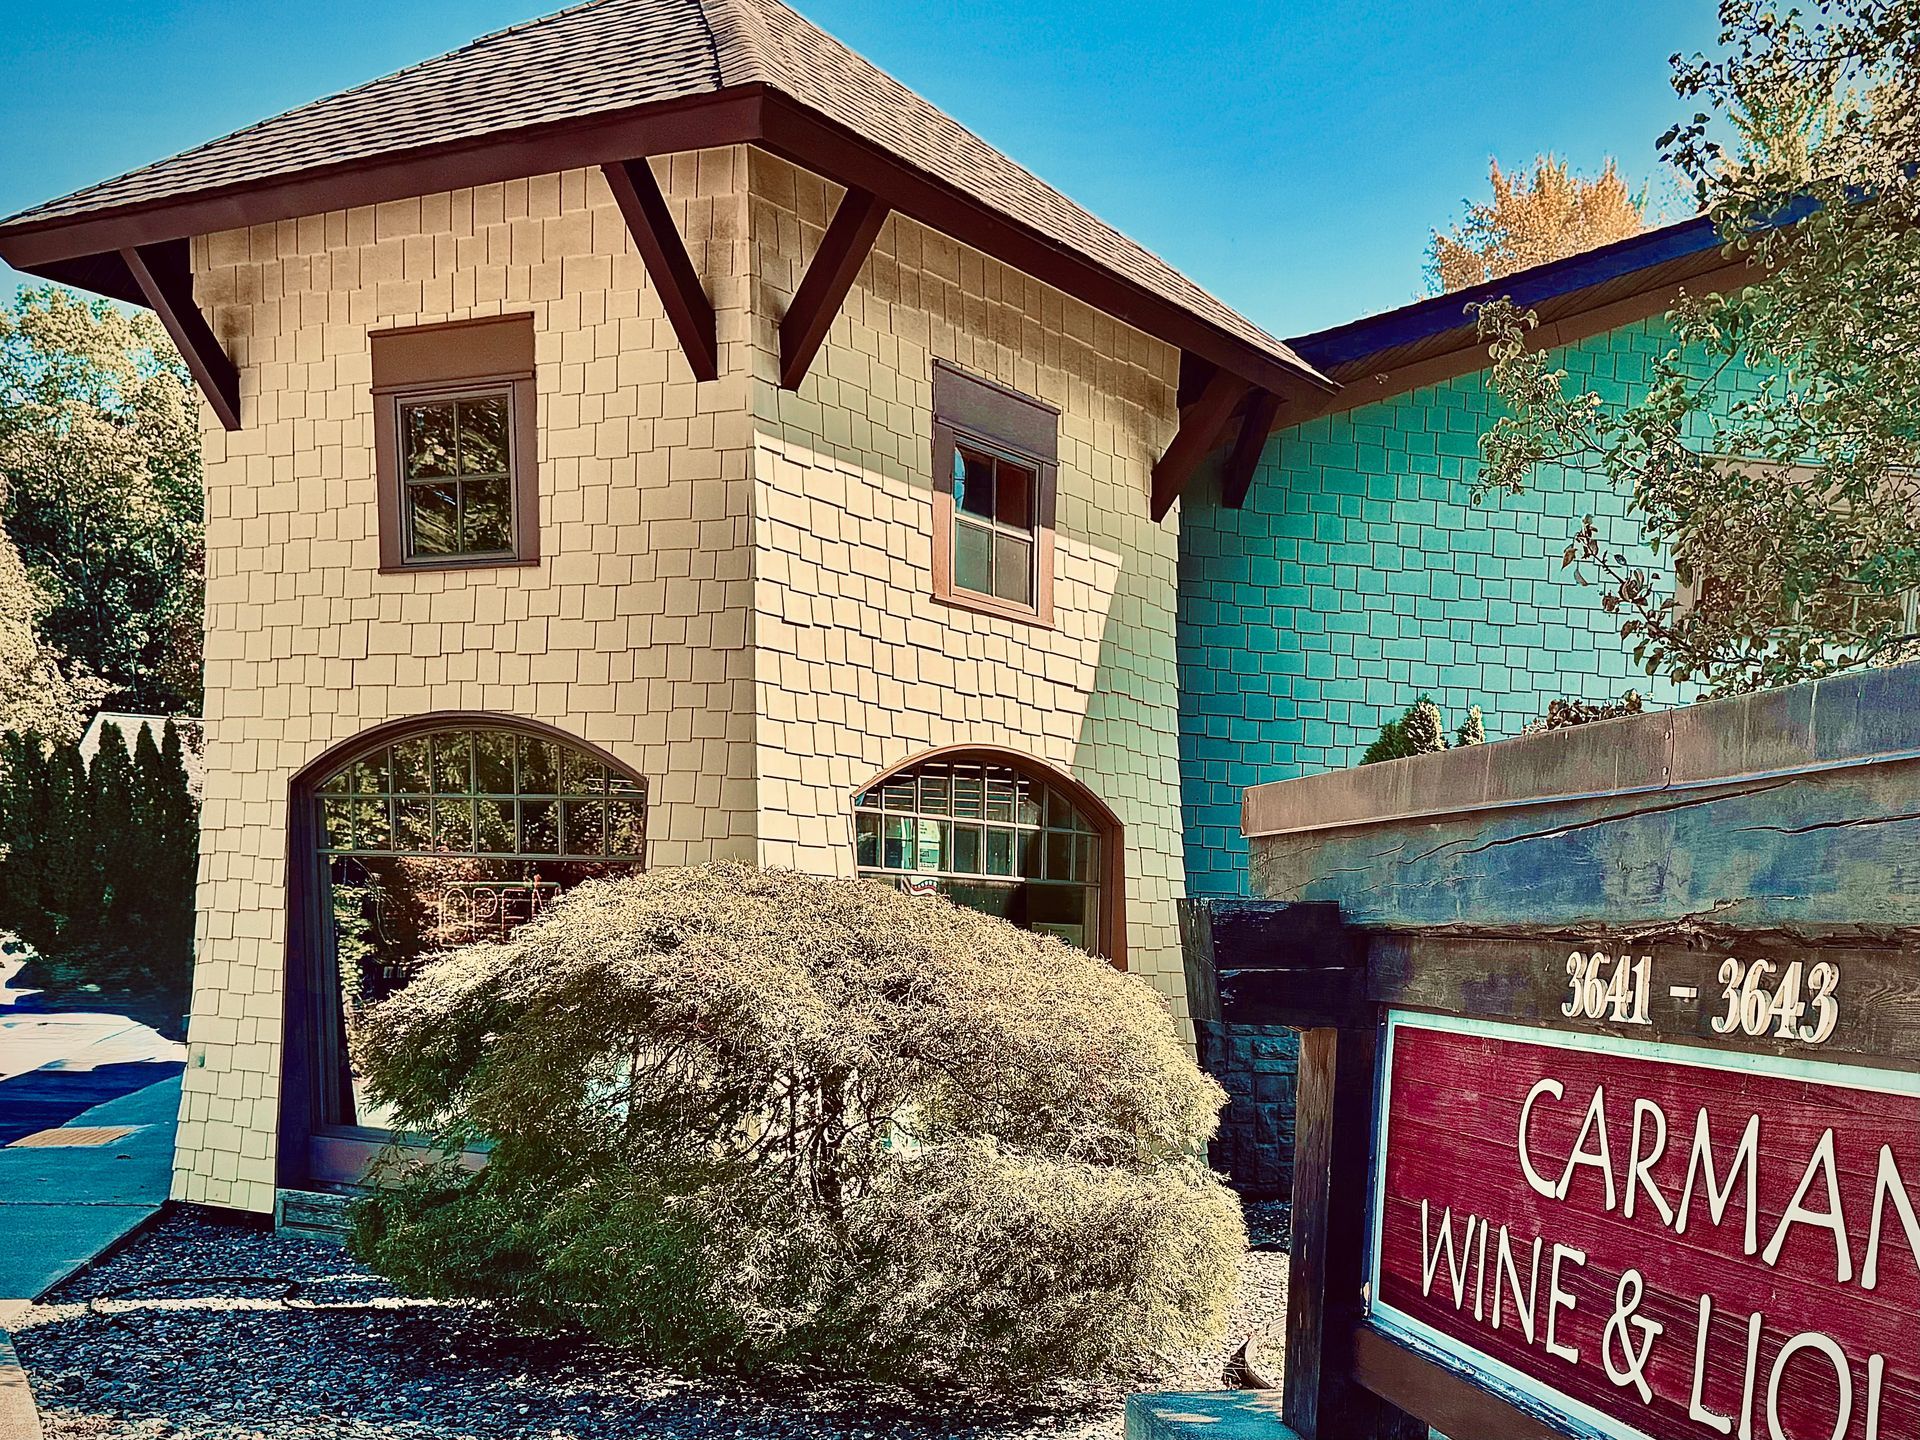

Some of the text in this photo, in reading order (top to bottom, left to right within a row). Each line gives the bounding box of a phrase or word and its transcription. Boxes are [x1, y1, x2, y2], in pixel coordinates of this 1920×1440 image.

[1561, 951, 1652, 1025] 3641
[1711, 957, 1840, 1044] 3643
[1421, 1199, 1585, 1364] WINE
[1602, 1269, 1664, 1404] &
